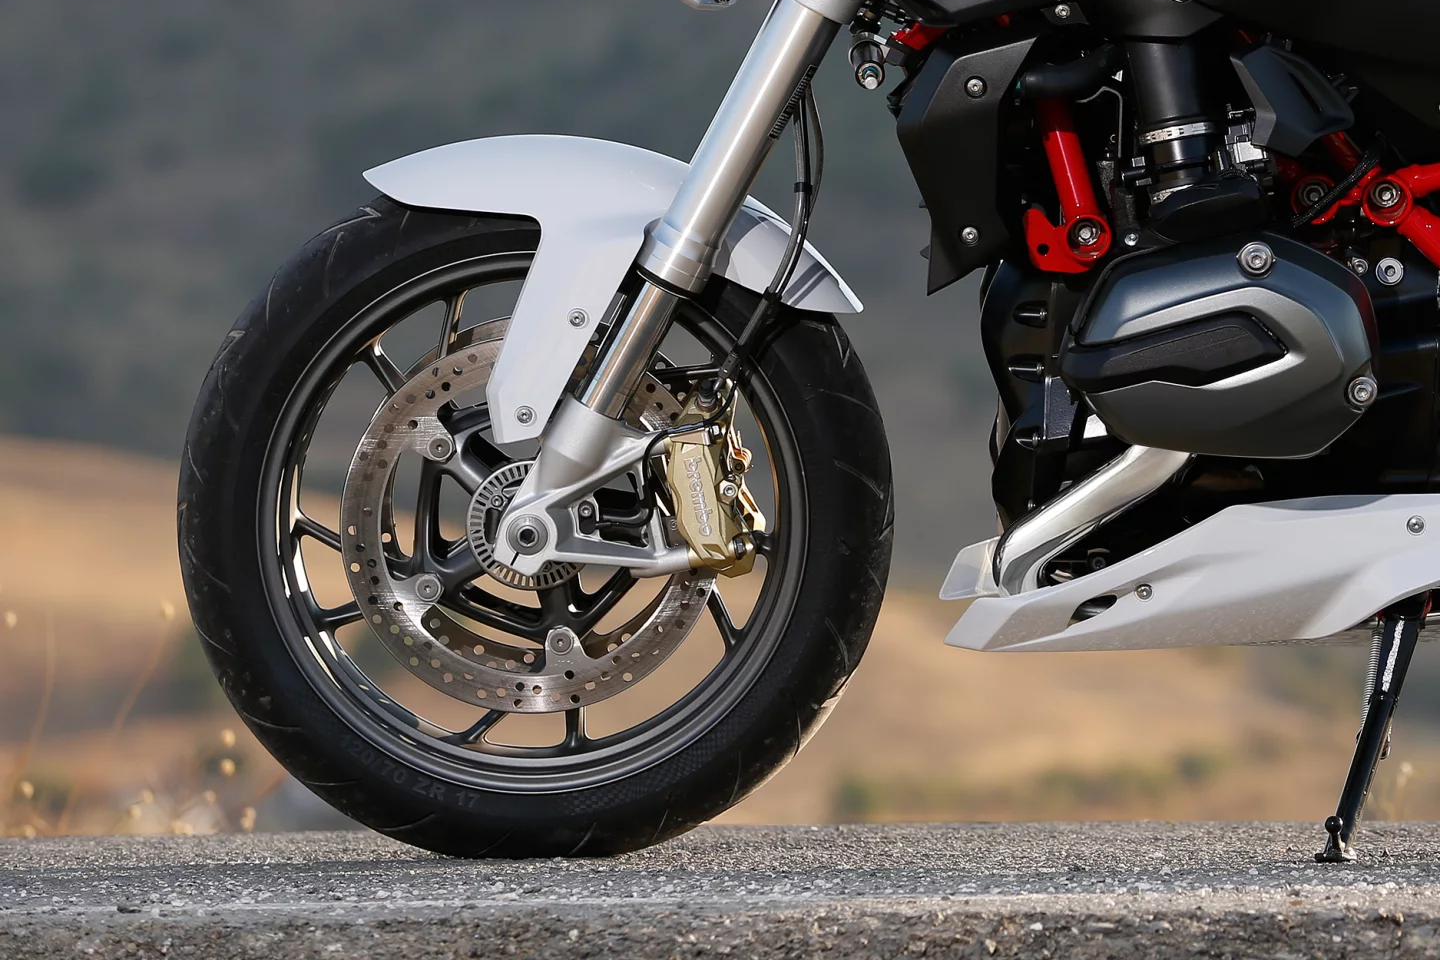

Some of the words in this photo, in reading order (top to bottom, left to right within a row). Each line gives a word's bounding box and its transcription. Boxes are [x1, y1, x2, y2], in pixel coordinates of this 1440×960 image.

[684, 456, 713, 536] brembo
[339, 734, 408, 784] 120/70
[412, 776, 446, 802] ZR
[455, 791, 481, 808] 17
